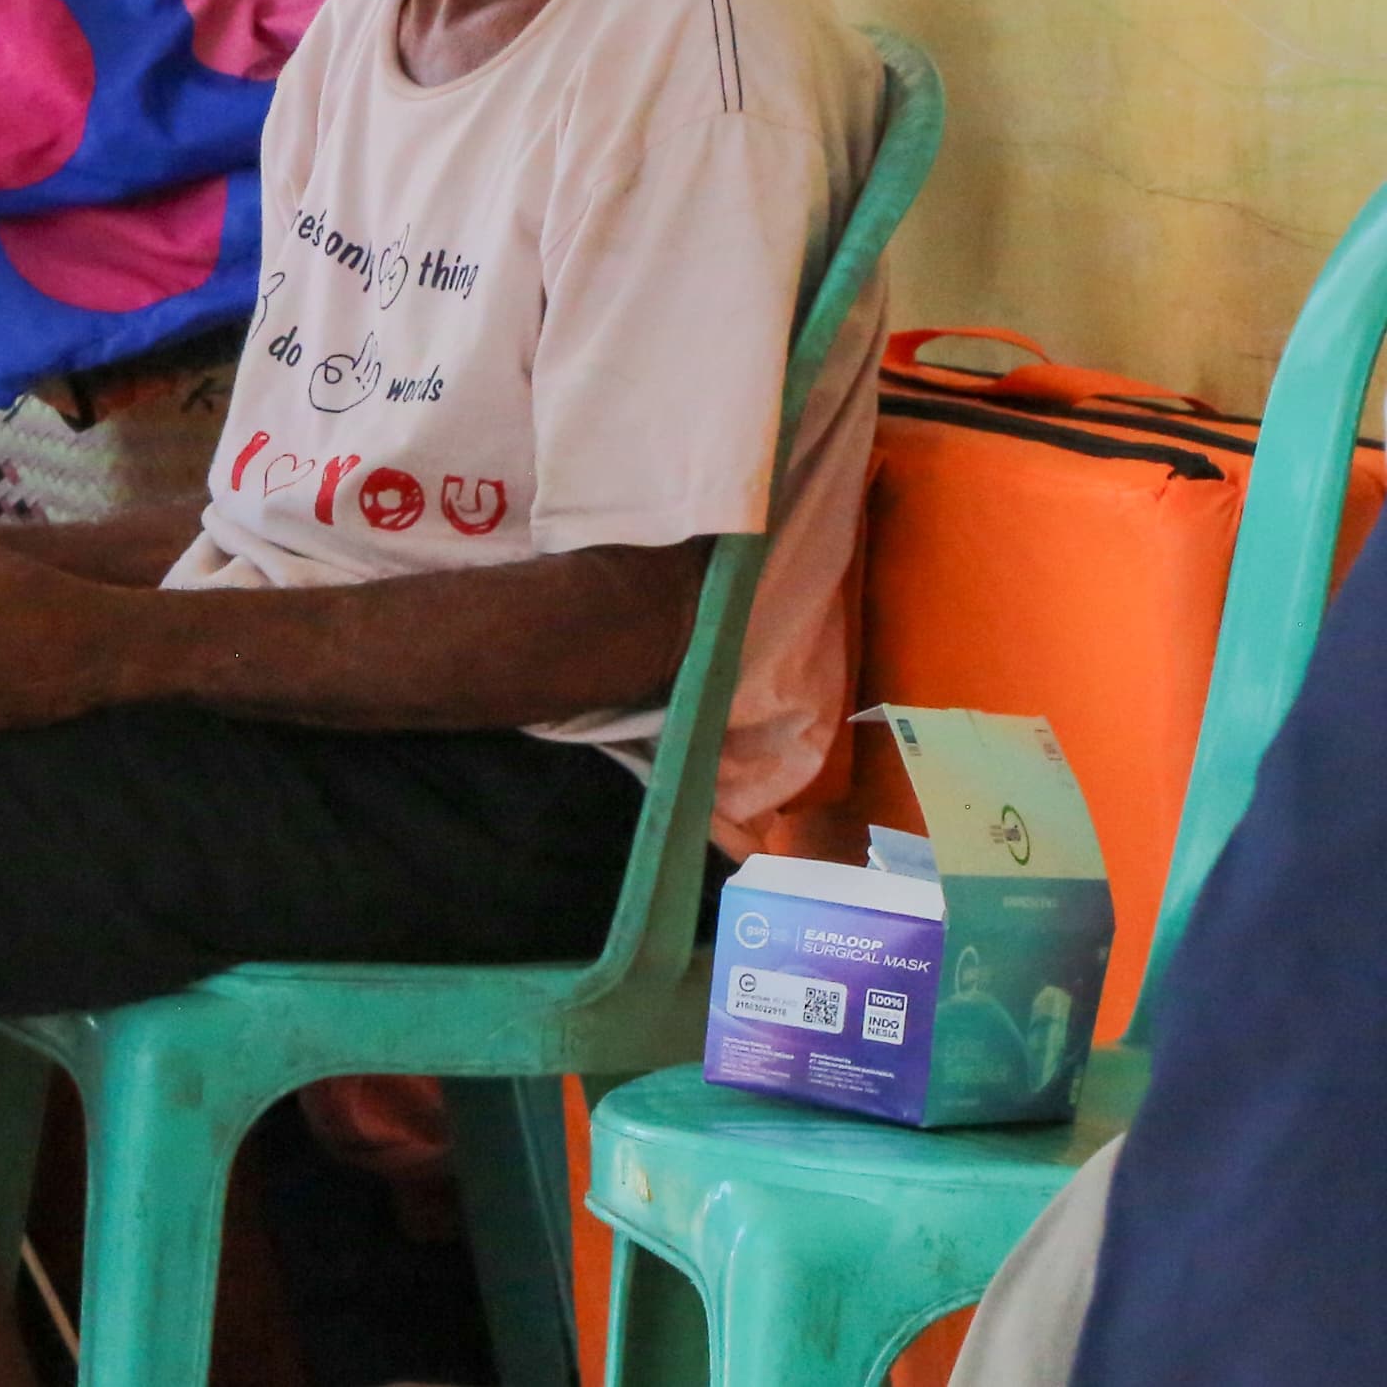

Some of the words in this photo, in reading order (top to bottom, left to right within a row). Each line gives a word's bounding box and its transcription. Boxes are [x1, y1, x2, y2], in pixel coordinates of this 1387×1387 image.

[418, 249, 480, 301] thing
[268, 325, 303, 368] do
[385, 364, 444, 404] words
[804, 928, 884, 952] EARLOOP
[802, 940, 880, 965] SURGICAL
[882, 955, 932, 974] MASK
[870, 993, 904, 1010] 100%
[867, 1026, 899, 1041] NESIA
[868, 1015, 901, 1031] INDO
